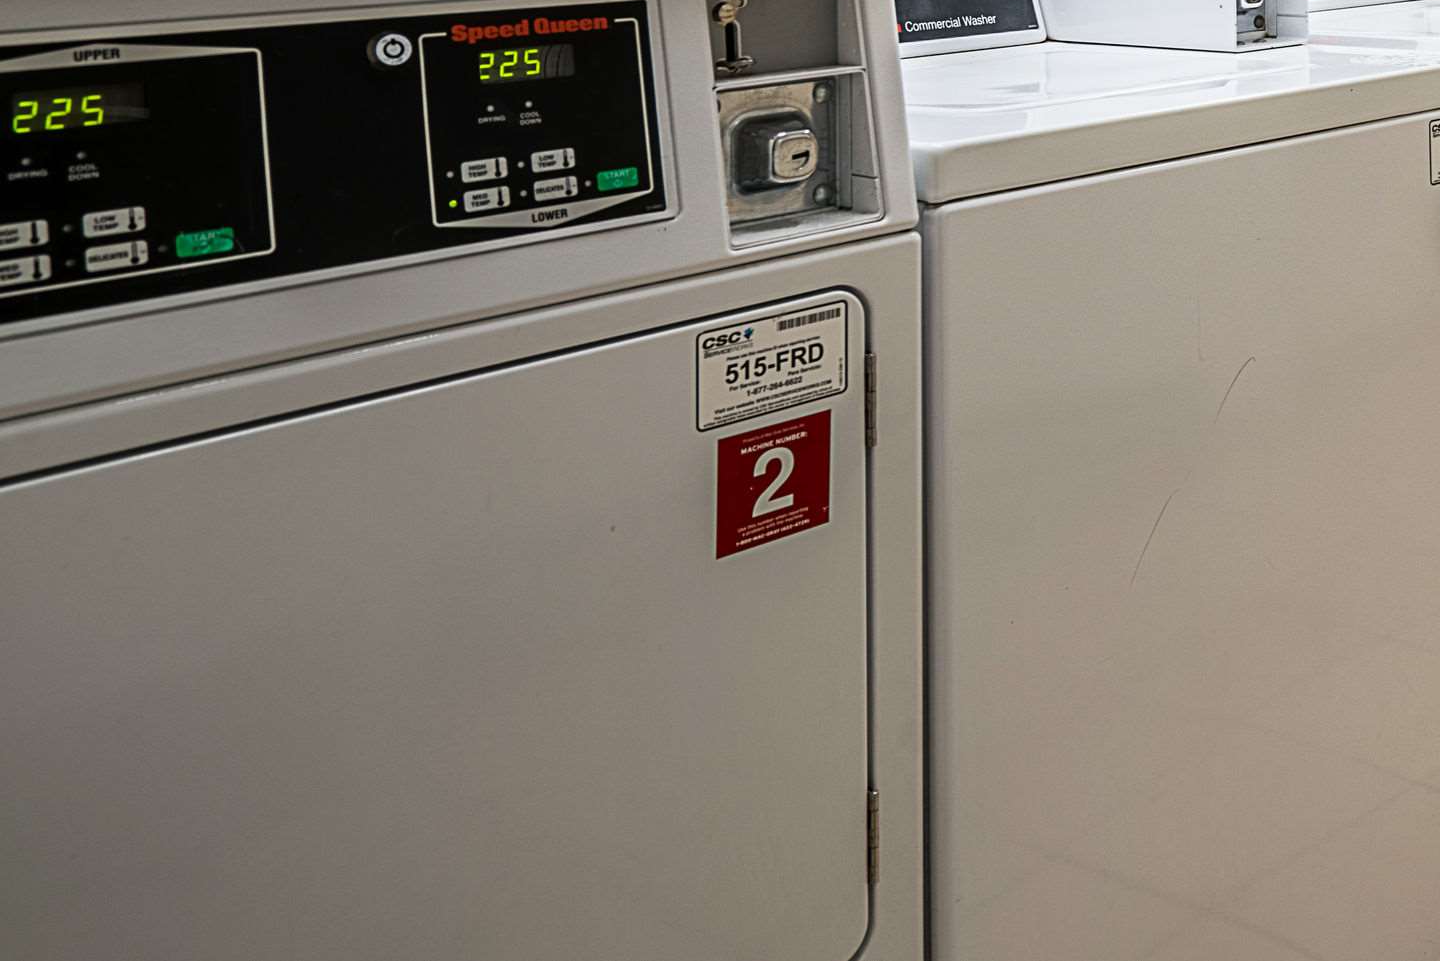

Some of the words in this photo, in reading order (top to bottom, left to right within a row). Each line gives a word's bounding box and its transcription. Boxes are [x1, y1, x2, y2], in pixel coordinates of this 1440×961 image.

[451, 19, 529, 44] Speed
[533, 16, 609, 35] Queen
[904, 17, 961, 33] Commercial
[961, 14, 997, 26] Washer
[73, 48, 121, 62] UPPER
[480, 48, 541, 81] 225
[13, 94, 104, 133] 225
[68, 171, 100, 182] DOWN
[471, 199, 491, 207] TEMP
[531, 208, 569, 223] LOWER
[702, 331, 742, 350] CSC
[725, 342, 824, 385] 515-FRD
[741, 440, 774, 455] MACHINE
[752, 446, 795, 518] 2
